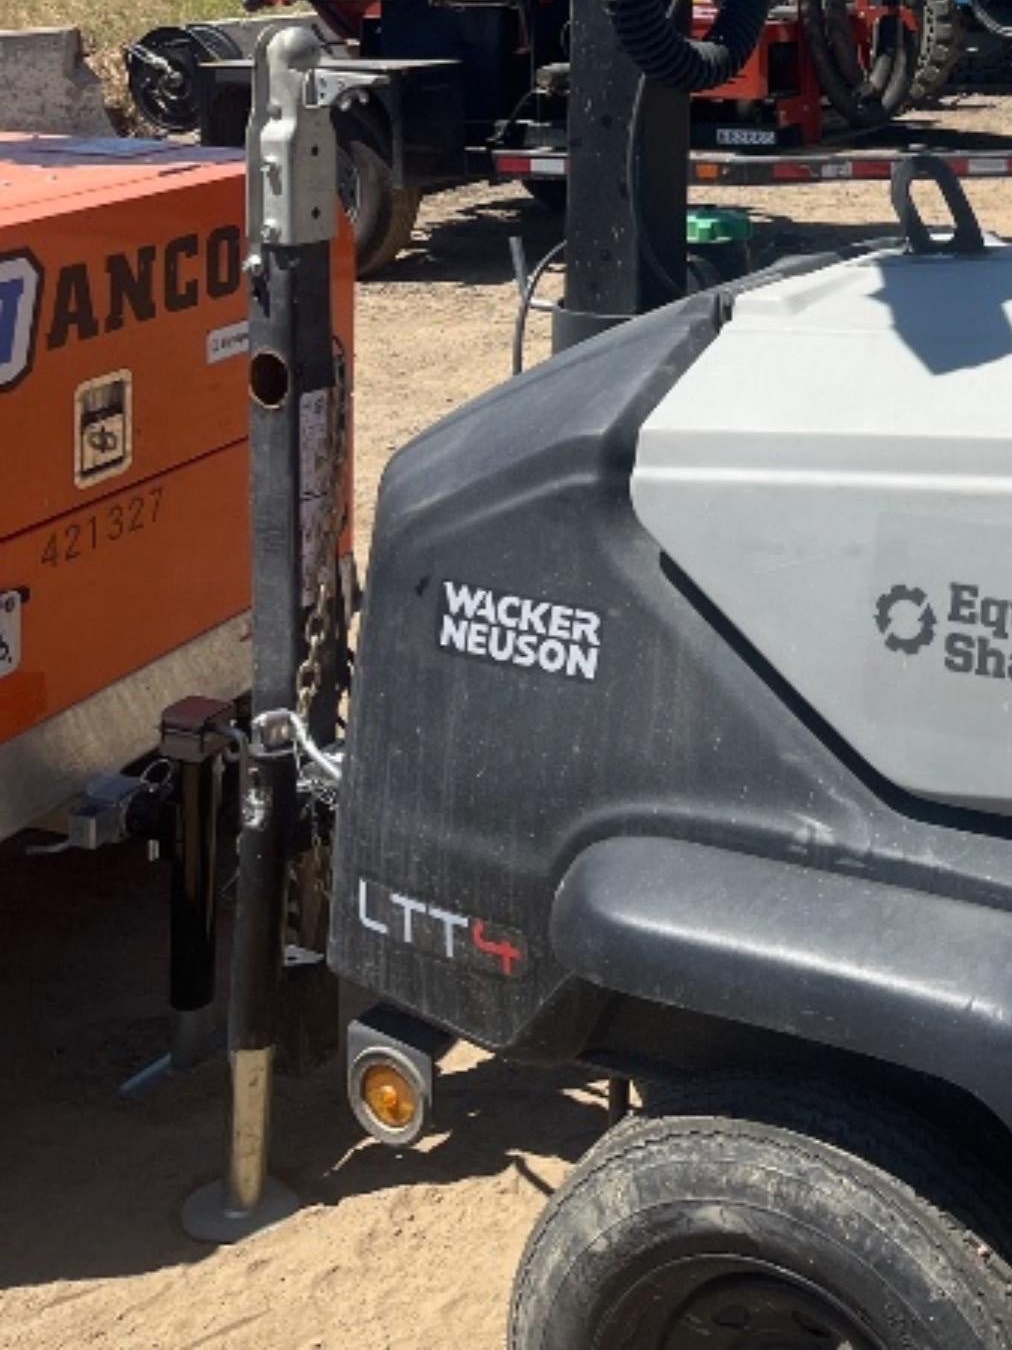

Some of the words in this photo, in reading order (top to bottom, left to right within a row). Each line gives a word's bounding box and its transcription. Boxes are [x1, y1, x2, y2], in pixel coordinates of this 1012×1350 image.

[41, 487, 163, 567] 421327
[440, 614, 598, 680] NEUSON
[443, 580, 601, 646] WACKER
[359, 877, 523, 976] LTT4
